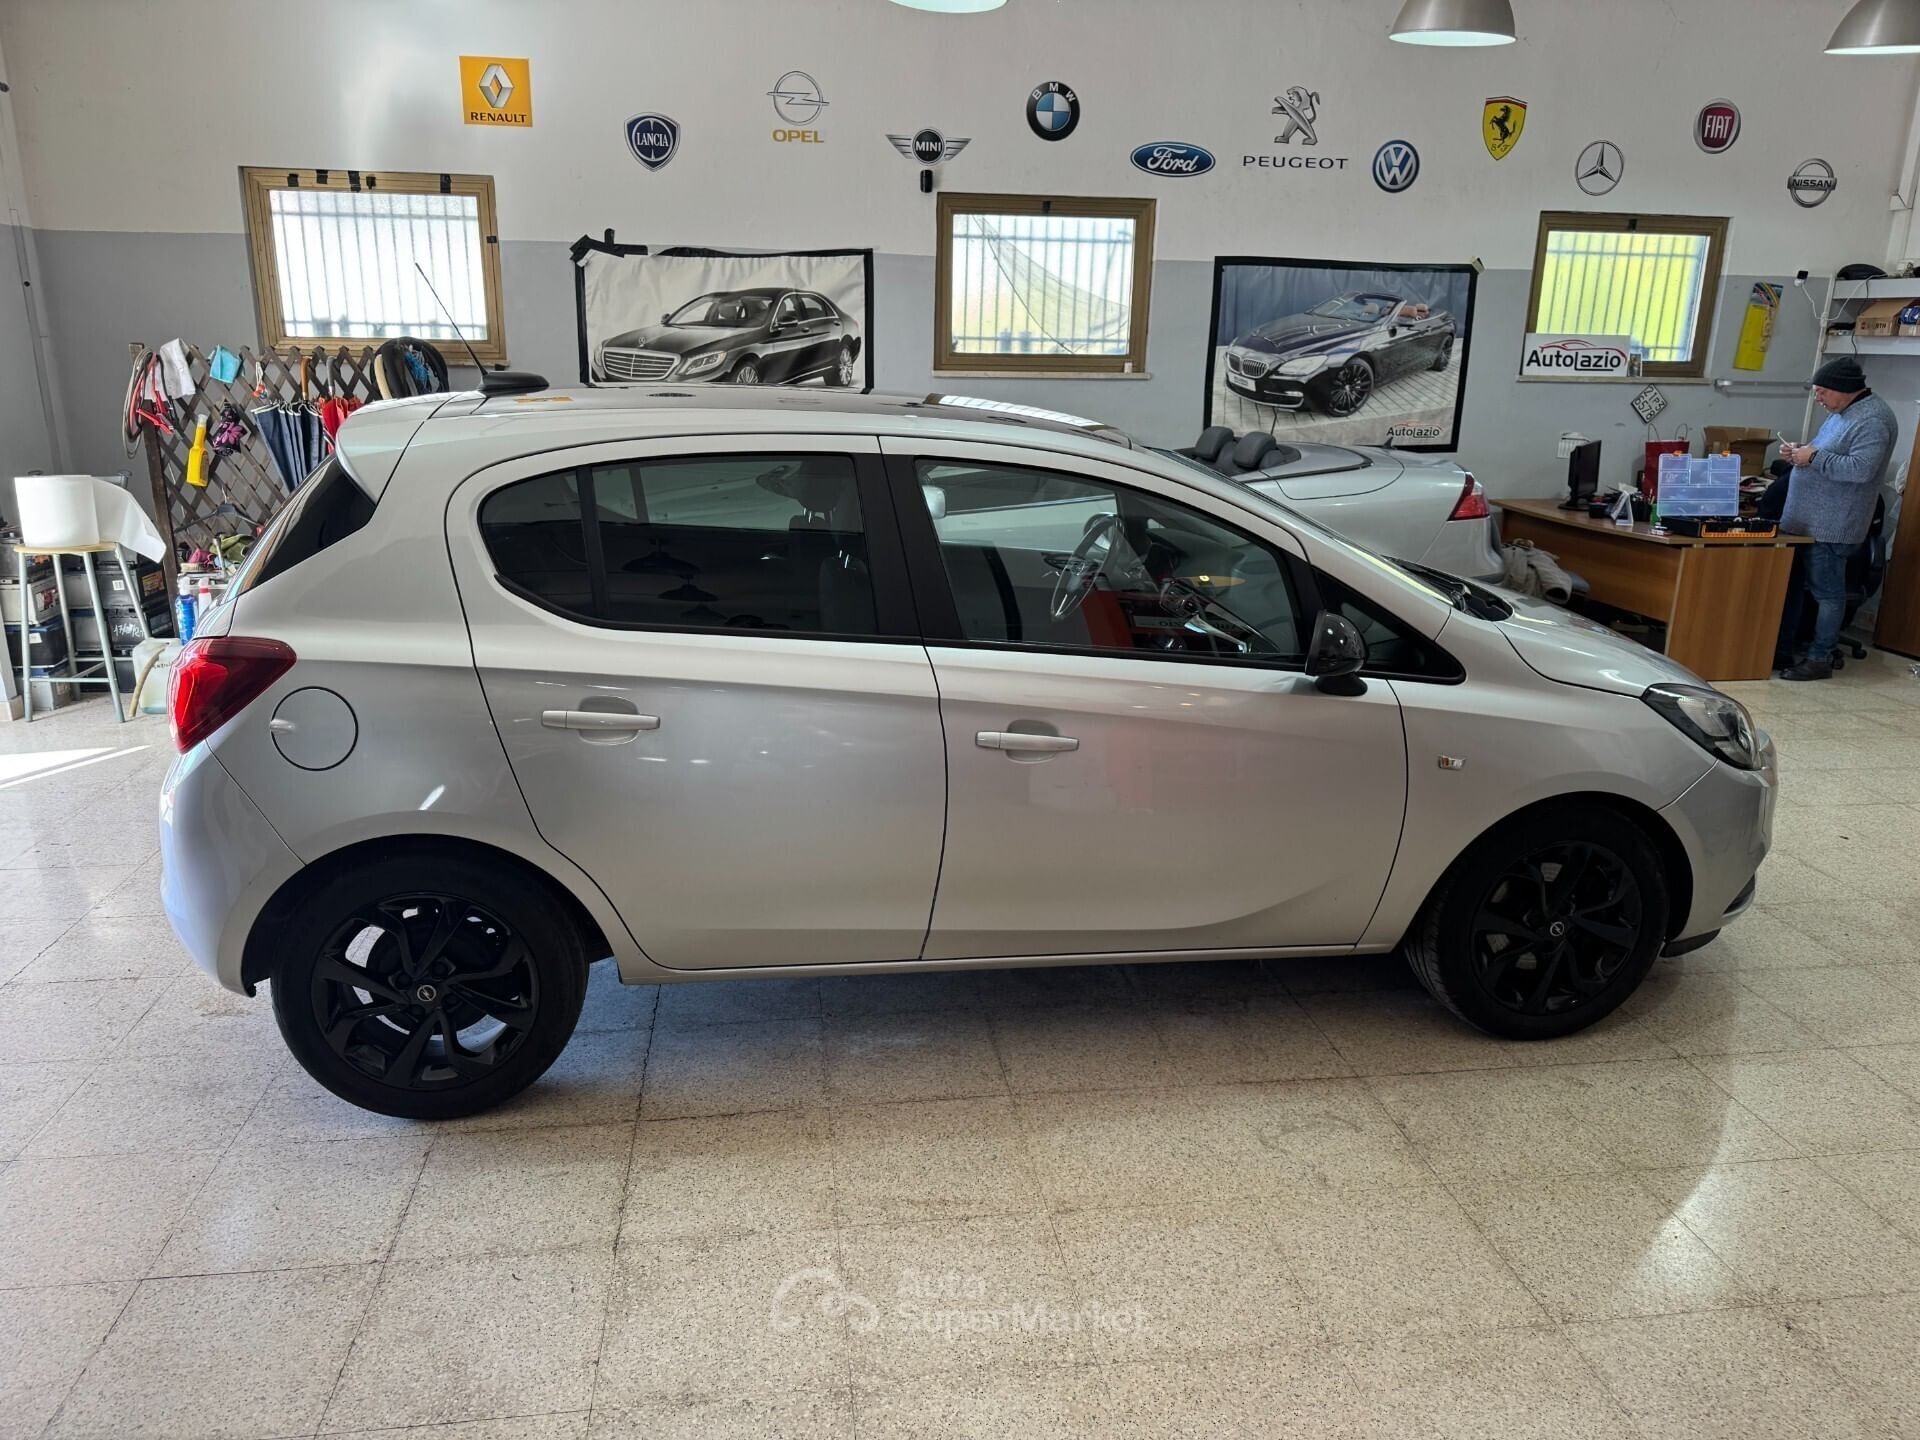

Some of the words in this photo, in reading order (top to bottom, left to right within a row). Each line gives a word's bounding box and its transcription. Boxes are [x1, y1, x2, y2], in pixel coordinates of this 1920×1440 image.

[1031, 82, 1076, 102] BMW
[470, 111, 528, 123] RENAULT
[1703, 115, 1733, 139] FIAT
[636, 132, 669, 147] LANCIA
[772, 129, 825, 143] OPEL
[915, 140, 942, 152] MINI
[1147, 146, 1200, 172] Ford
[1242, 155, 1349, 170] PEUGEOT
[1792, 179, 1832, 188] NISSAN
